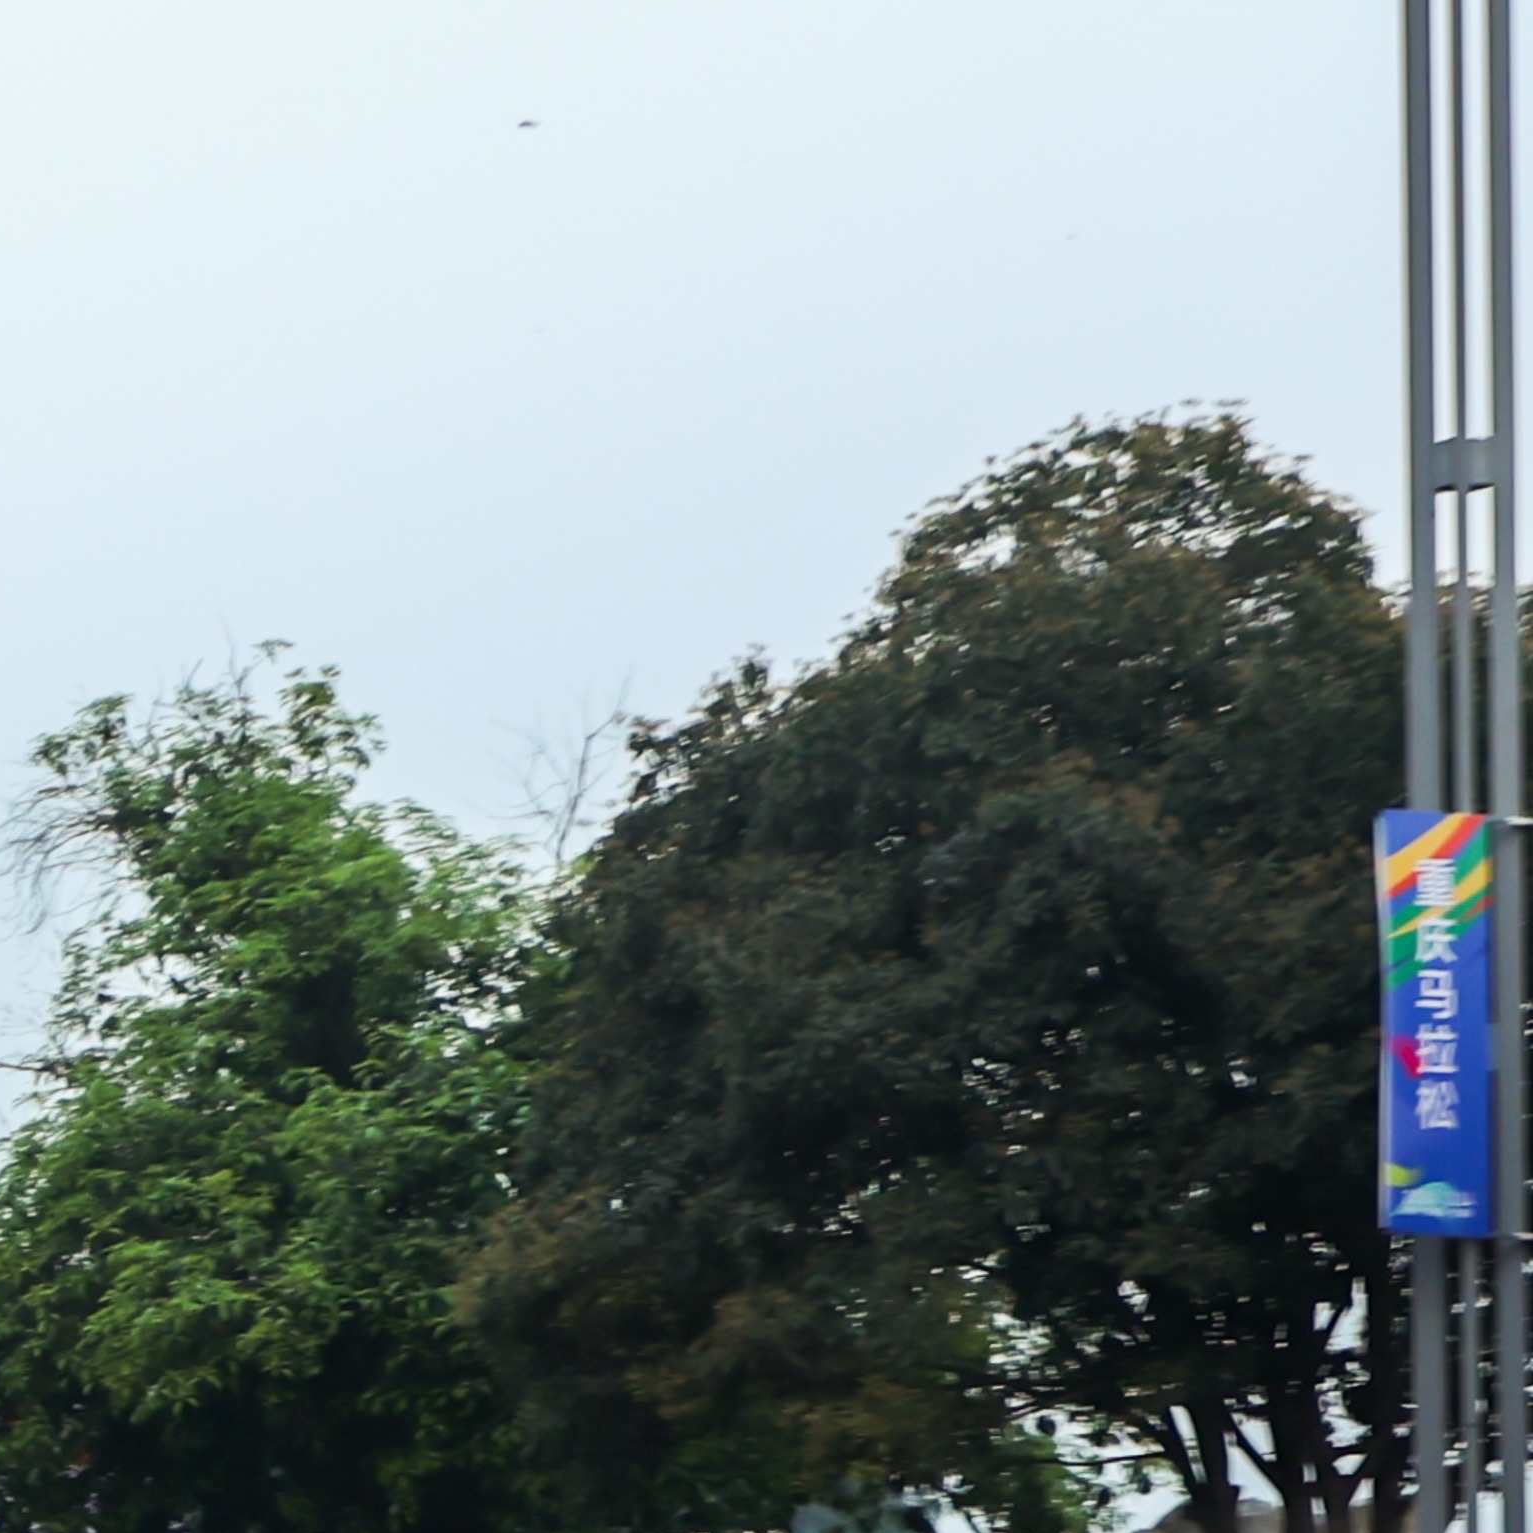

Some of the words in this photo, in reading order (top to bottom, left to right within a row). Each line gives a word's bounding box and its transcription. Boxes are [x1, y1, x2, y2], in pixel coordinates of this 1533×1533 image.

[1413, 857, 1460, 1130] 重庆马拉松
